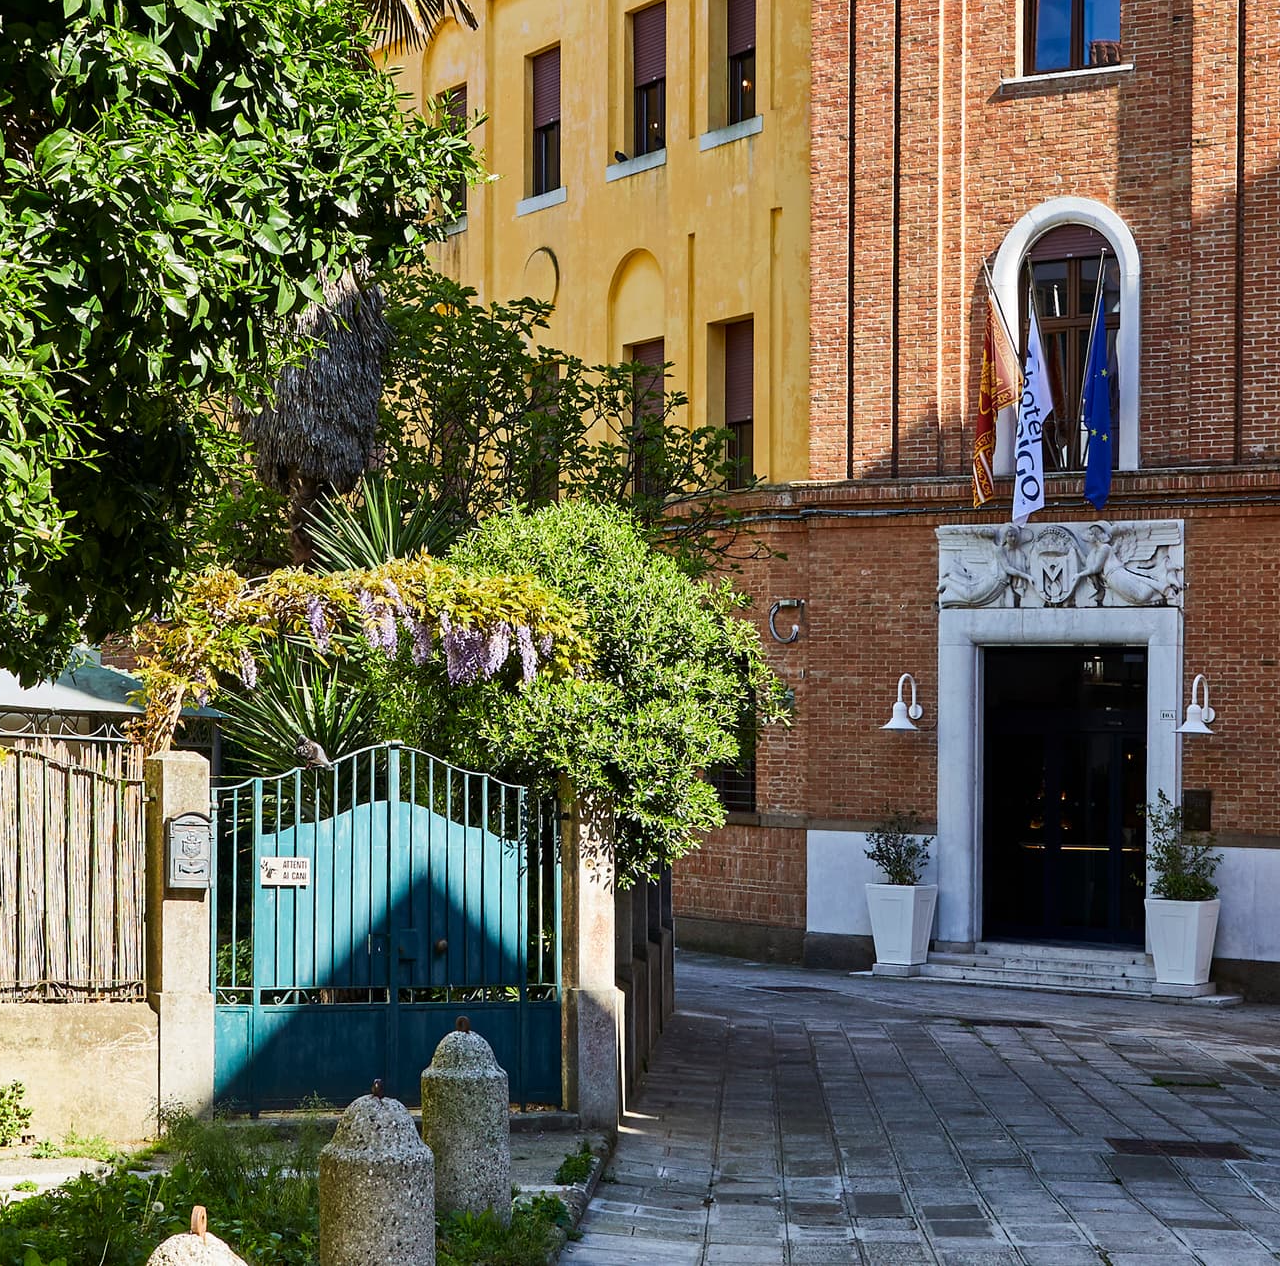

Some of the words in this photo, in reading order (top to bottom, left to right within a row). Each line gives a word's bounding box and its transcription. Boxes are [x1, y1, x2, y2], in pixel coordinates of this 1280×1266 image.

[1023, 369, 1042, 444] hotel
[282, 860, 308, 869] ATTENTI
[282, 871, 290, 879] AI
[291, 872, 307, 880] CANI
